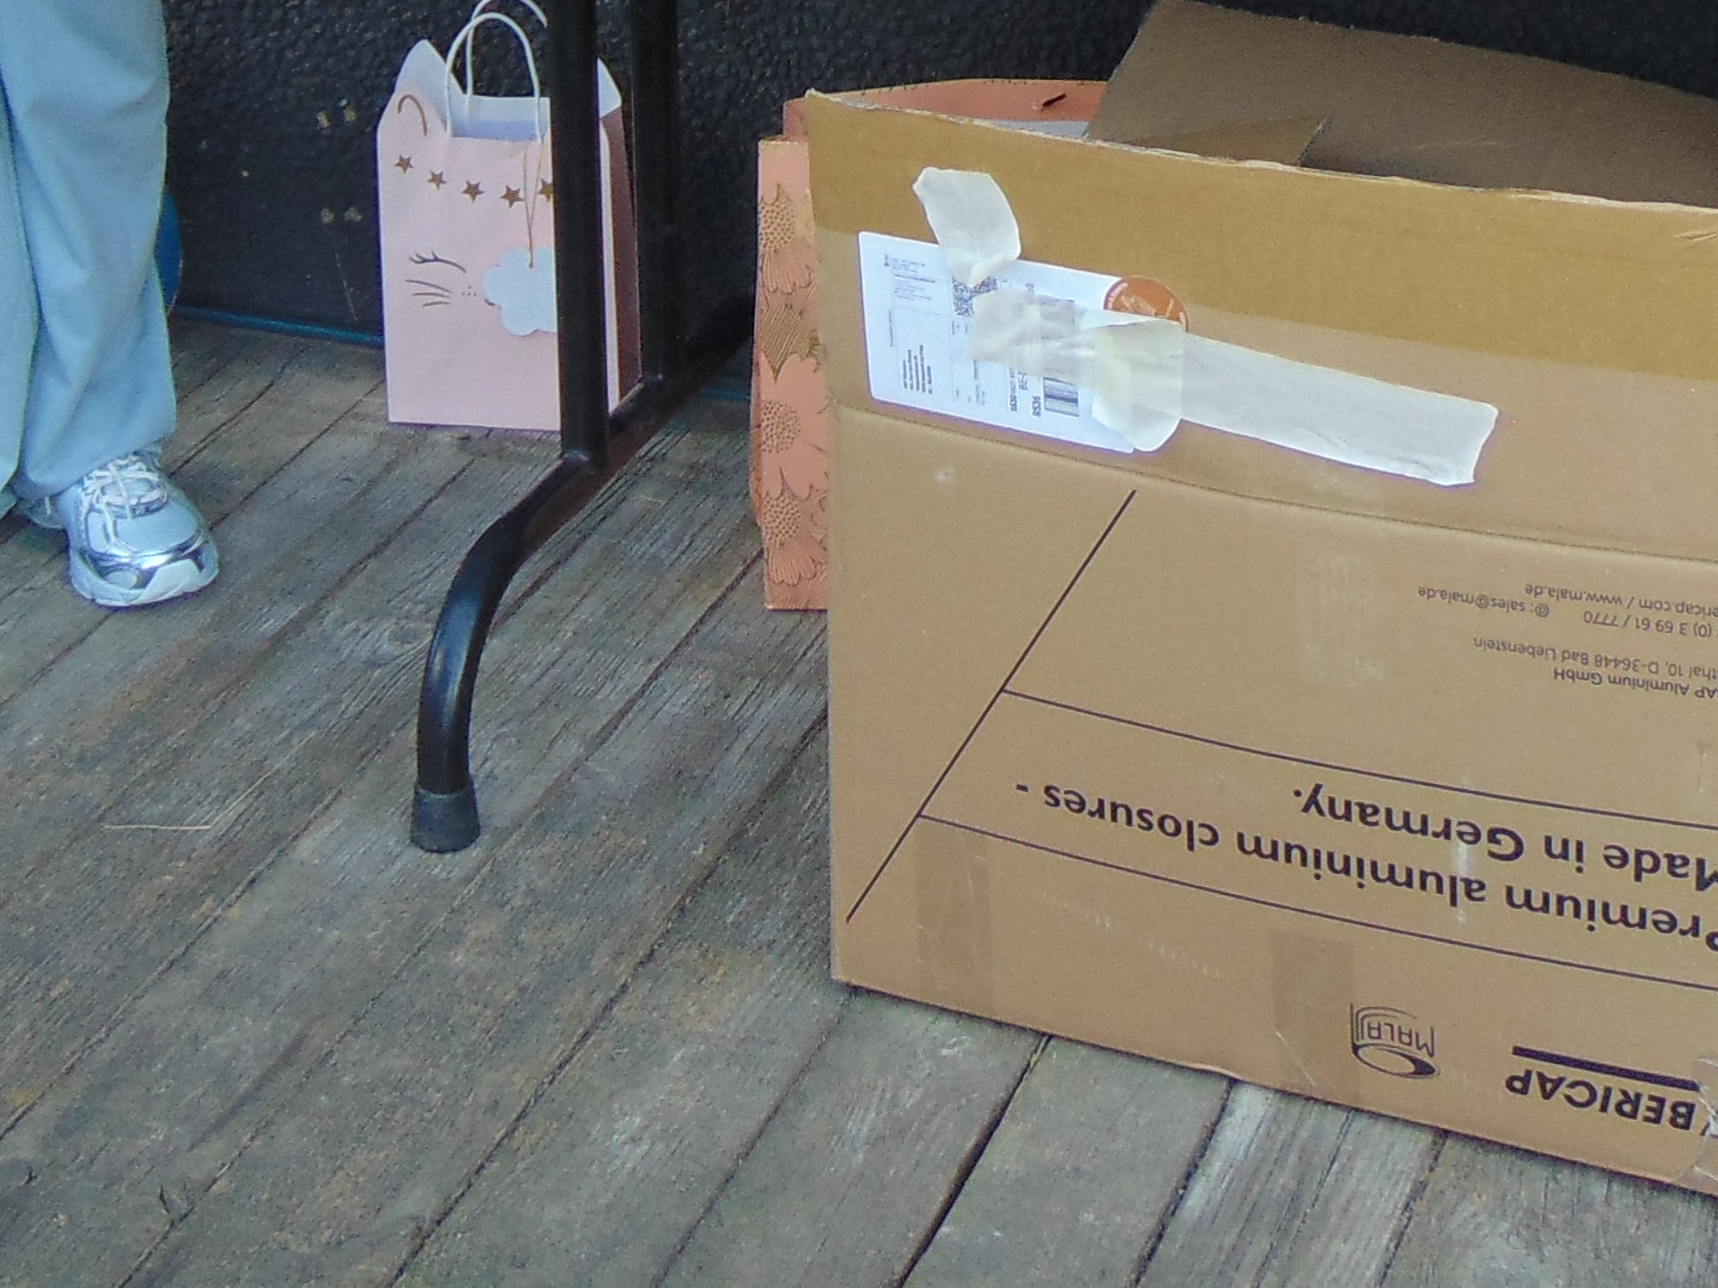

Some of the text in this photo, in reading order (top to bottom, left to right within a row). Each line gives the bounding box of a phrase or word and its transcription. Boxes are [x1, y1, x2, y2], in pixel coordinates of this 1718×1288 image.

[1417, 585, 1526, 613] sales@mala.de
[1524, 583, 1623, 606] www.mala.de
[1583, 610, 1619, 628] 7770
[1635, 617, 1651, 631] 61
[1655, 619, 1674, 634] 69
[1679, 622, 1688, 636] 3
[1693, 622, 1712, 638] (0)
[1473, 637, 1556, 662] Liebenstein
[1561, 648, 1589, 666] Bad
[1594, 653, 1659, 675] D-36448
[1665, 660, 1683, 677] 10,
[1553, 667, 1603, 685] GmbH
[1607, 675, 1690, 697] Aluminium
[1043, 784, 1220, 852] closures
[1292, 782, 1525, 862] Germany.
[1544, 834, 1584, 874] in
[1236, 830, 1487, 908] aluminium
[1367, 1021, 1435, 1057] MALA
[1505, 1068, 1696, 1131] BERICAP
